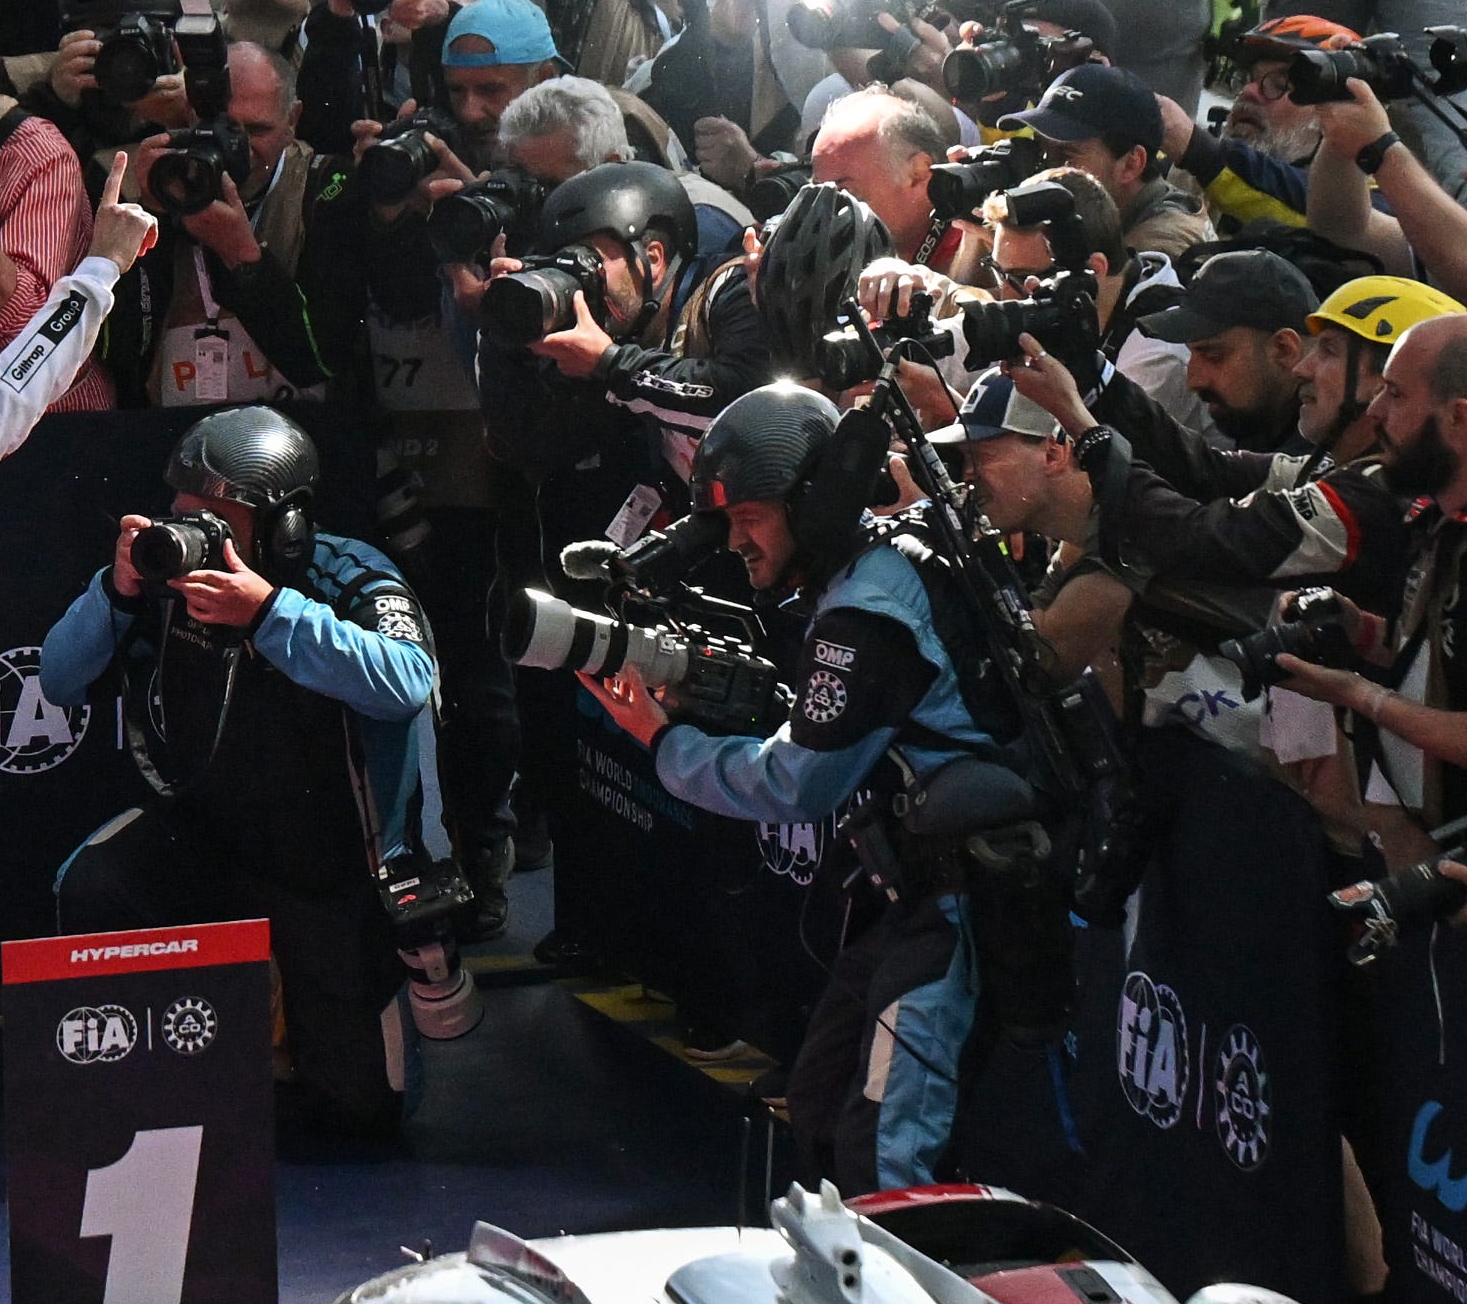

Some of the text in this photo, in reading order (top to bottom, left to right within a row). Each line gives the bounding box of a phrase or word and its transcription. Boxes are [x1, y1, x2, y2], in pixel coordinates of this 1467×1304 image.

[916, 232, 937, 264] EOS
[49, 299, 81, 334] Group
[10, 343, 46, 383] Giltrap
[370, 353, 423, 388] 77
[374, 597, 411, 613] OMP
[814, 642, 854, 665] OMP
[595, 750, 633, 791] WORLD
[70, 938, 200, 964] HYPERCAR
